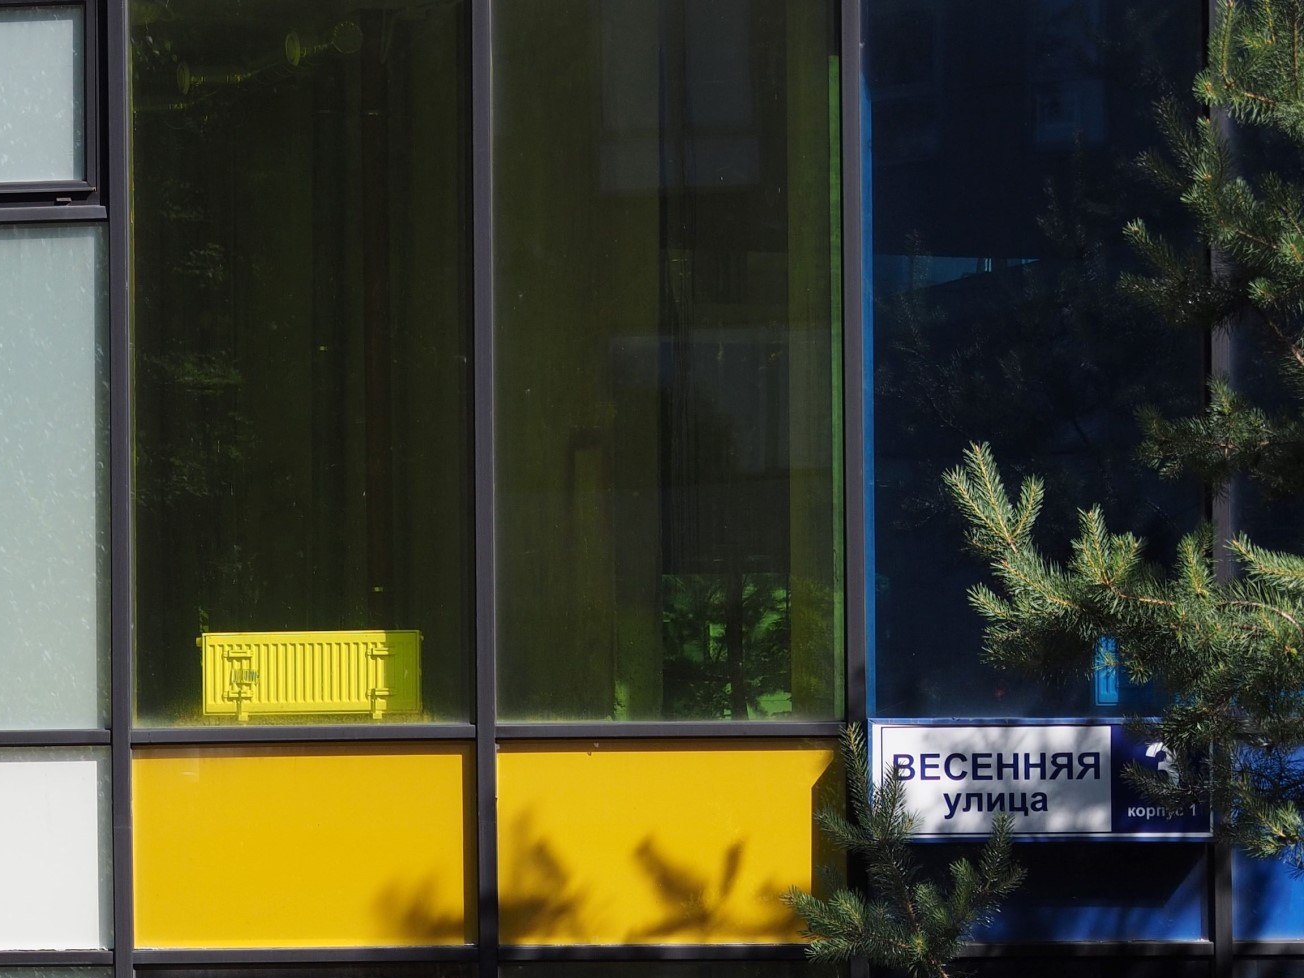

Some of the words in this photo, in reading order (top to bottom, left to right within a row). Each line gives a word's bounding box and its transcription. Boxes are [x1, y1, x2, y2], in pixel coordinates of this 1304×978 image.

[892, 752, 1100, 780] ВЕСЕННЯЯ
[1145, 742, 1180, 791] 3
[943, 791, 1048, 819] улица
[1189, 803, 1196, 816] 1
